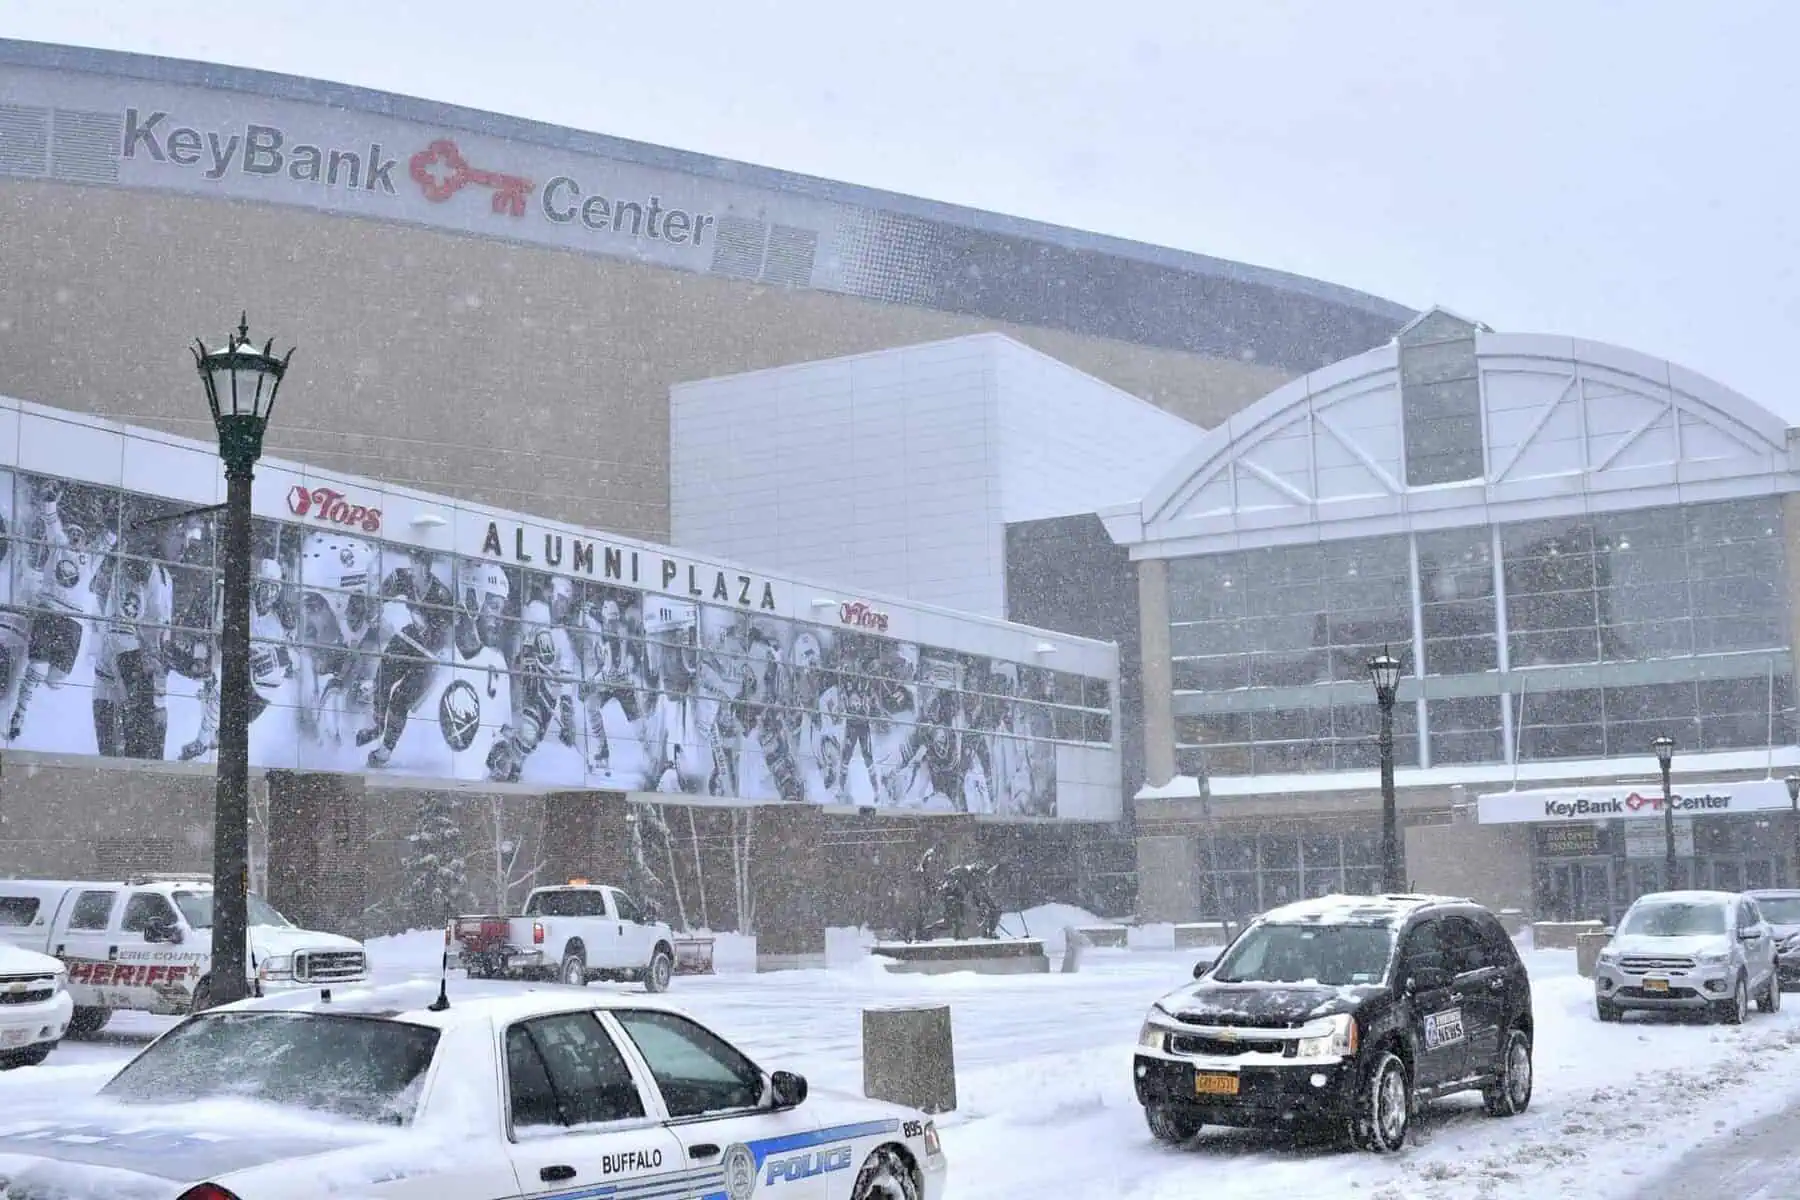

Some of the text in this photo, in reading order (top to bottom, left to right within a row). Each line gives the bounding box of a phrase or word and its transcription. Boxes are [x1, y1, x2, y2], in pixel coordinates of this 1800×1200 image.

[122, 107, 714, 246] KeyBank Center
[483, 521, 775, 610] ALUMNI PLAZA
[1544, 794, 1732, 817] KeyBank Center
[119, 951, 209, 960] ERIE COUNTY
[66, 962, 189, 986] HERIFF
[903, 1121, 922, 1138] 895
[602, 1148, 662, 1174] BUFFALO
[766, 1145, 852, 1186] POLICE
